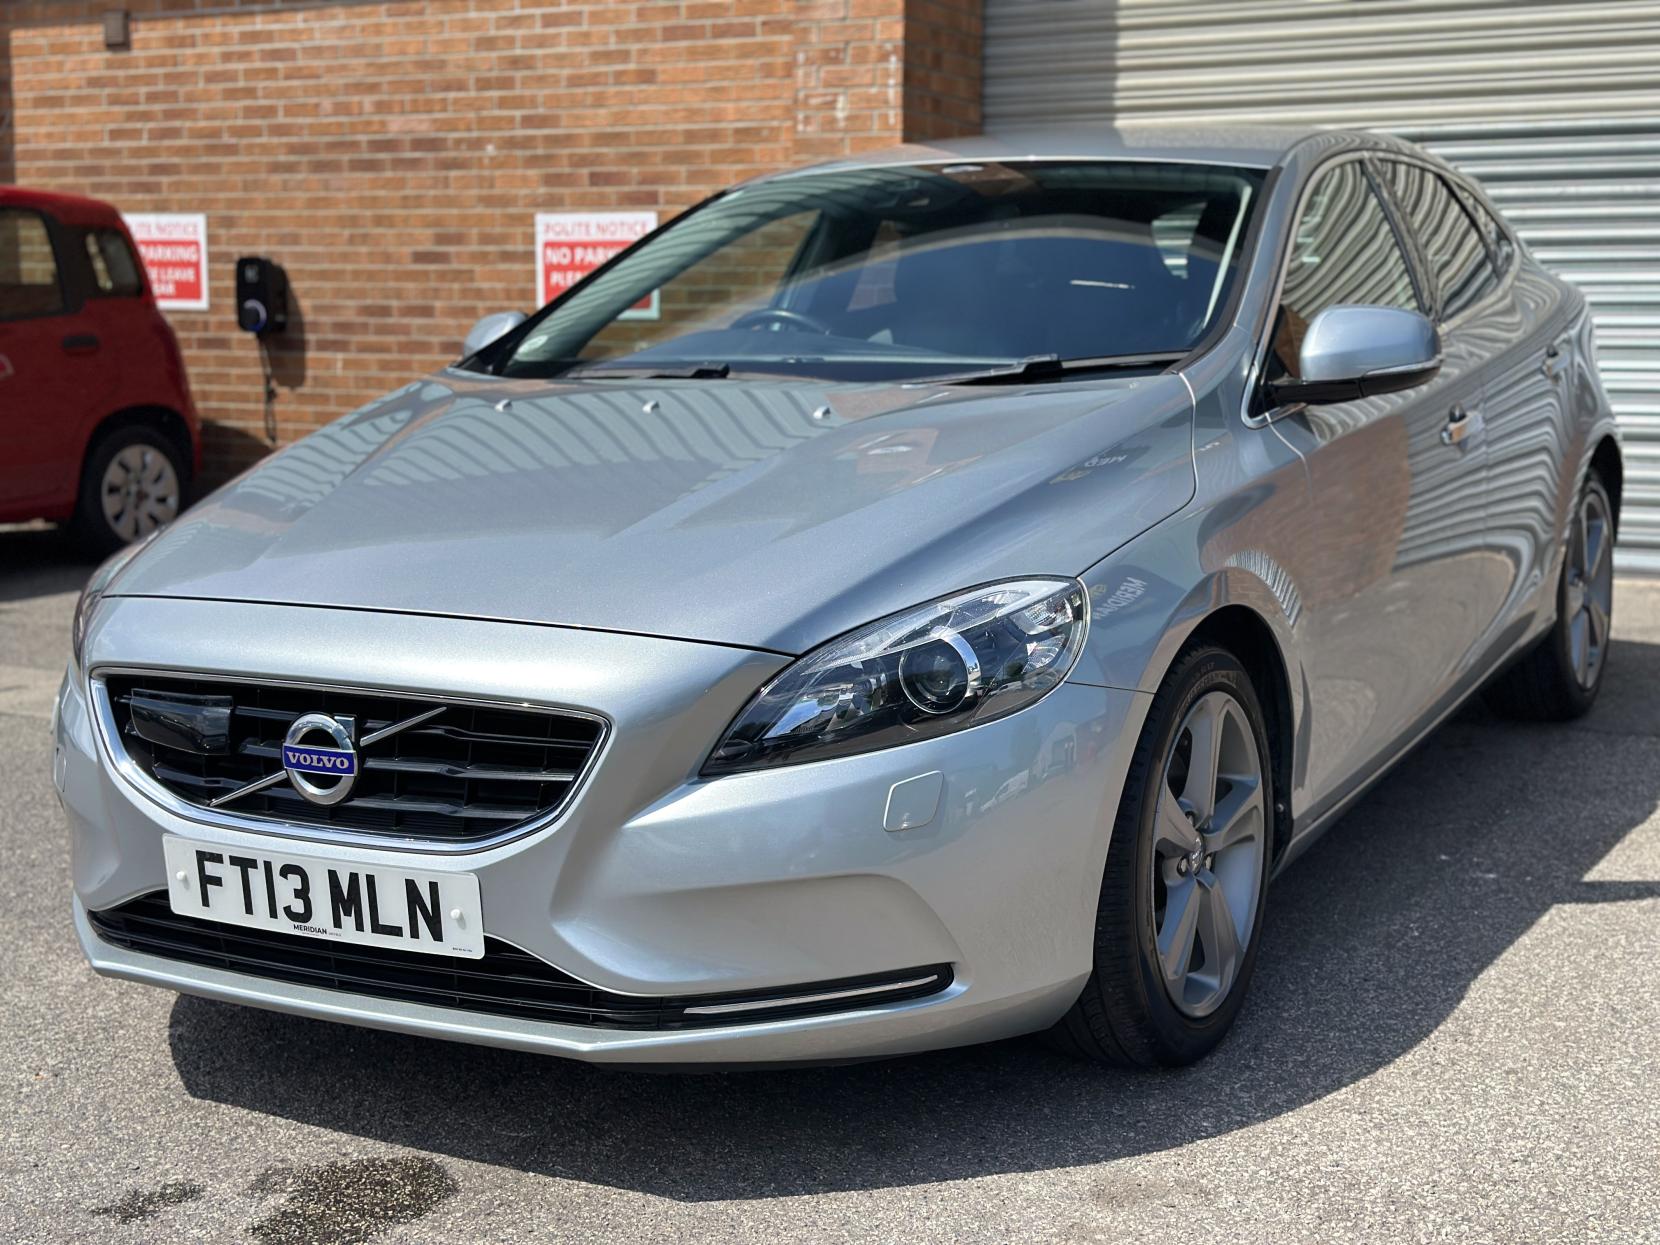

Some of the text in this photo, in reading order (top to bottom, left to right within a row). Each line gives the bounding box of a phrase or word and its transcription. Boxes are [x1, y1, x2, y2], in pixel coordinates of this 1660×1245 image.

[155, 223, 198, 238] NOTICE
[543, 221, 648, 237] POLITE NOTICE
[545, 246, 622, 266] NO PARK
[286, 751, 349, 769] VOLVO
[195, 849, 444, 943] FT13 MLN
[293, 924, 327, 935] MERIDIAN
